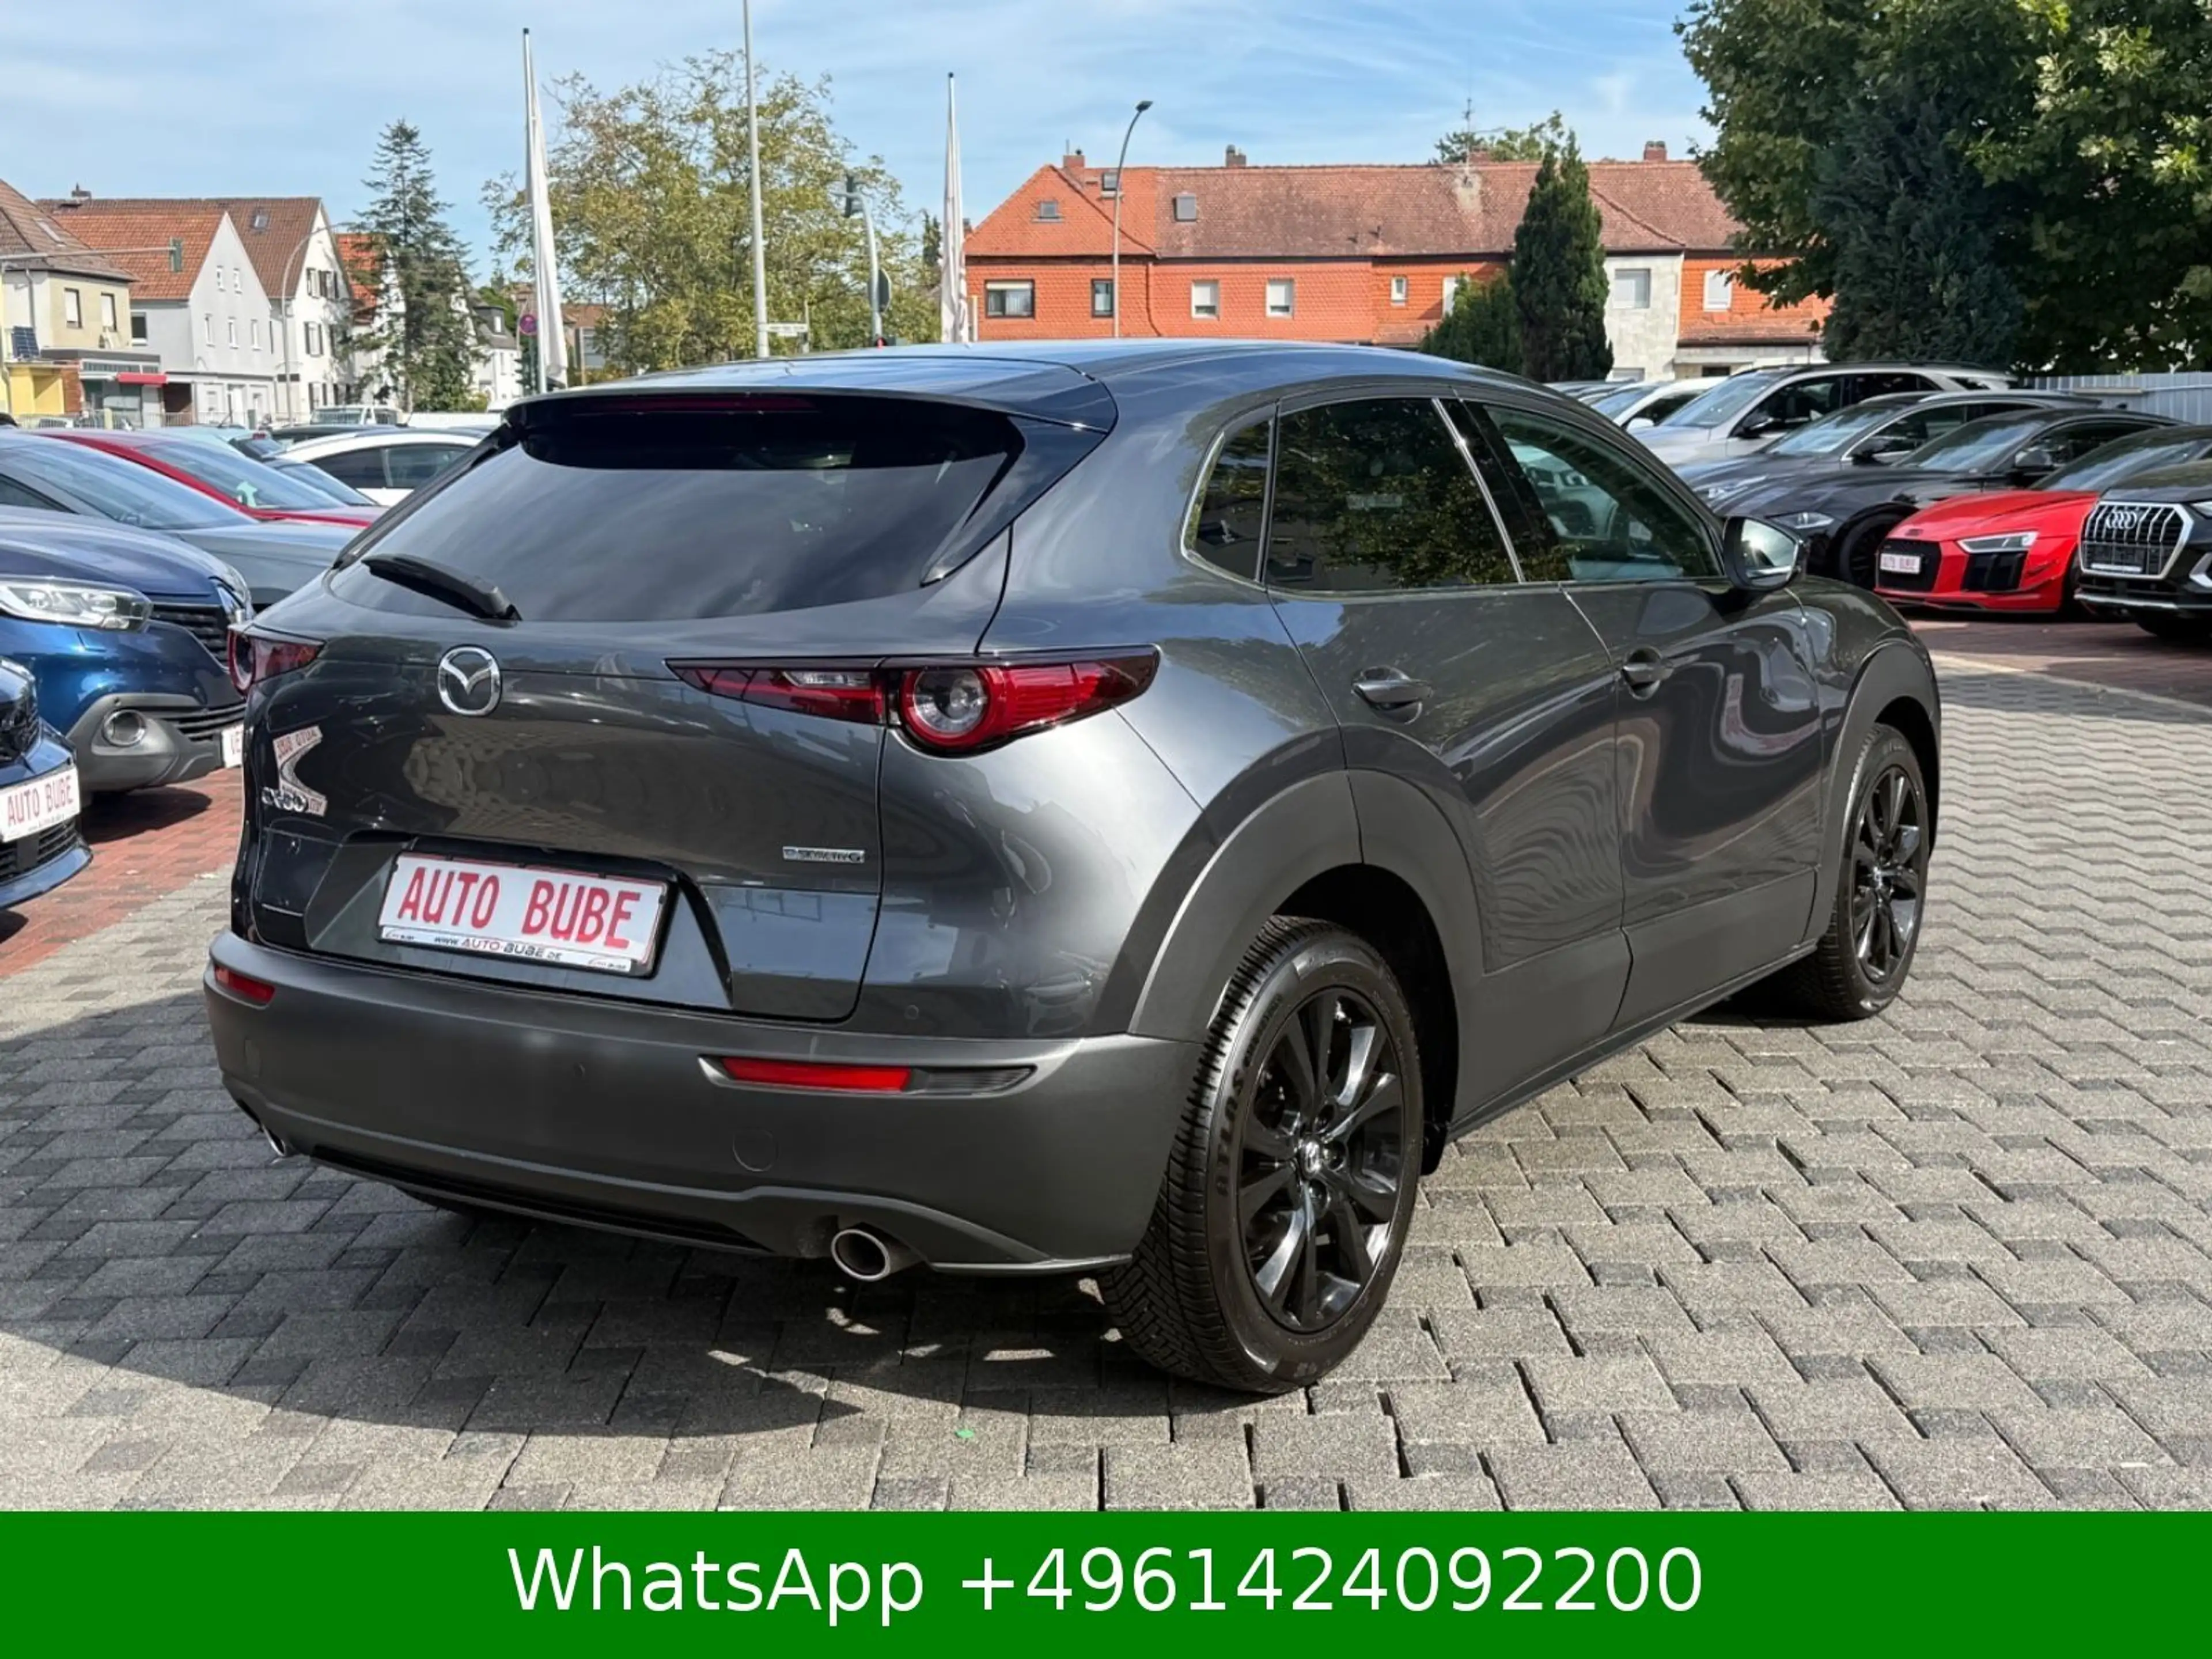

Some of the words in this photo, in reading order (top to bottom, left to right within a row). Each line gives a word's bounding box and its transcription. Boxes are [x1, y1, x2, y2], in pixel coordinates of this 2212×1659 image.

[7, 787, 40, 827] AUTO
[44, 775, 73, 813] BUBE
[397, 867, 501, 929] AUTO
[521, 879, 641, 949] BUBE
